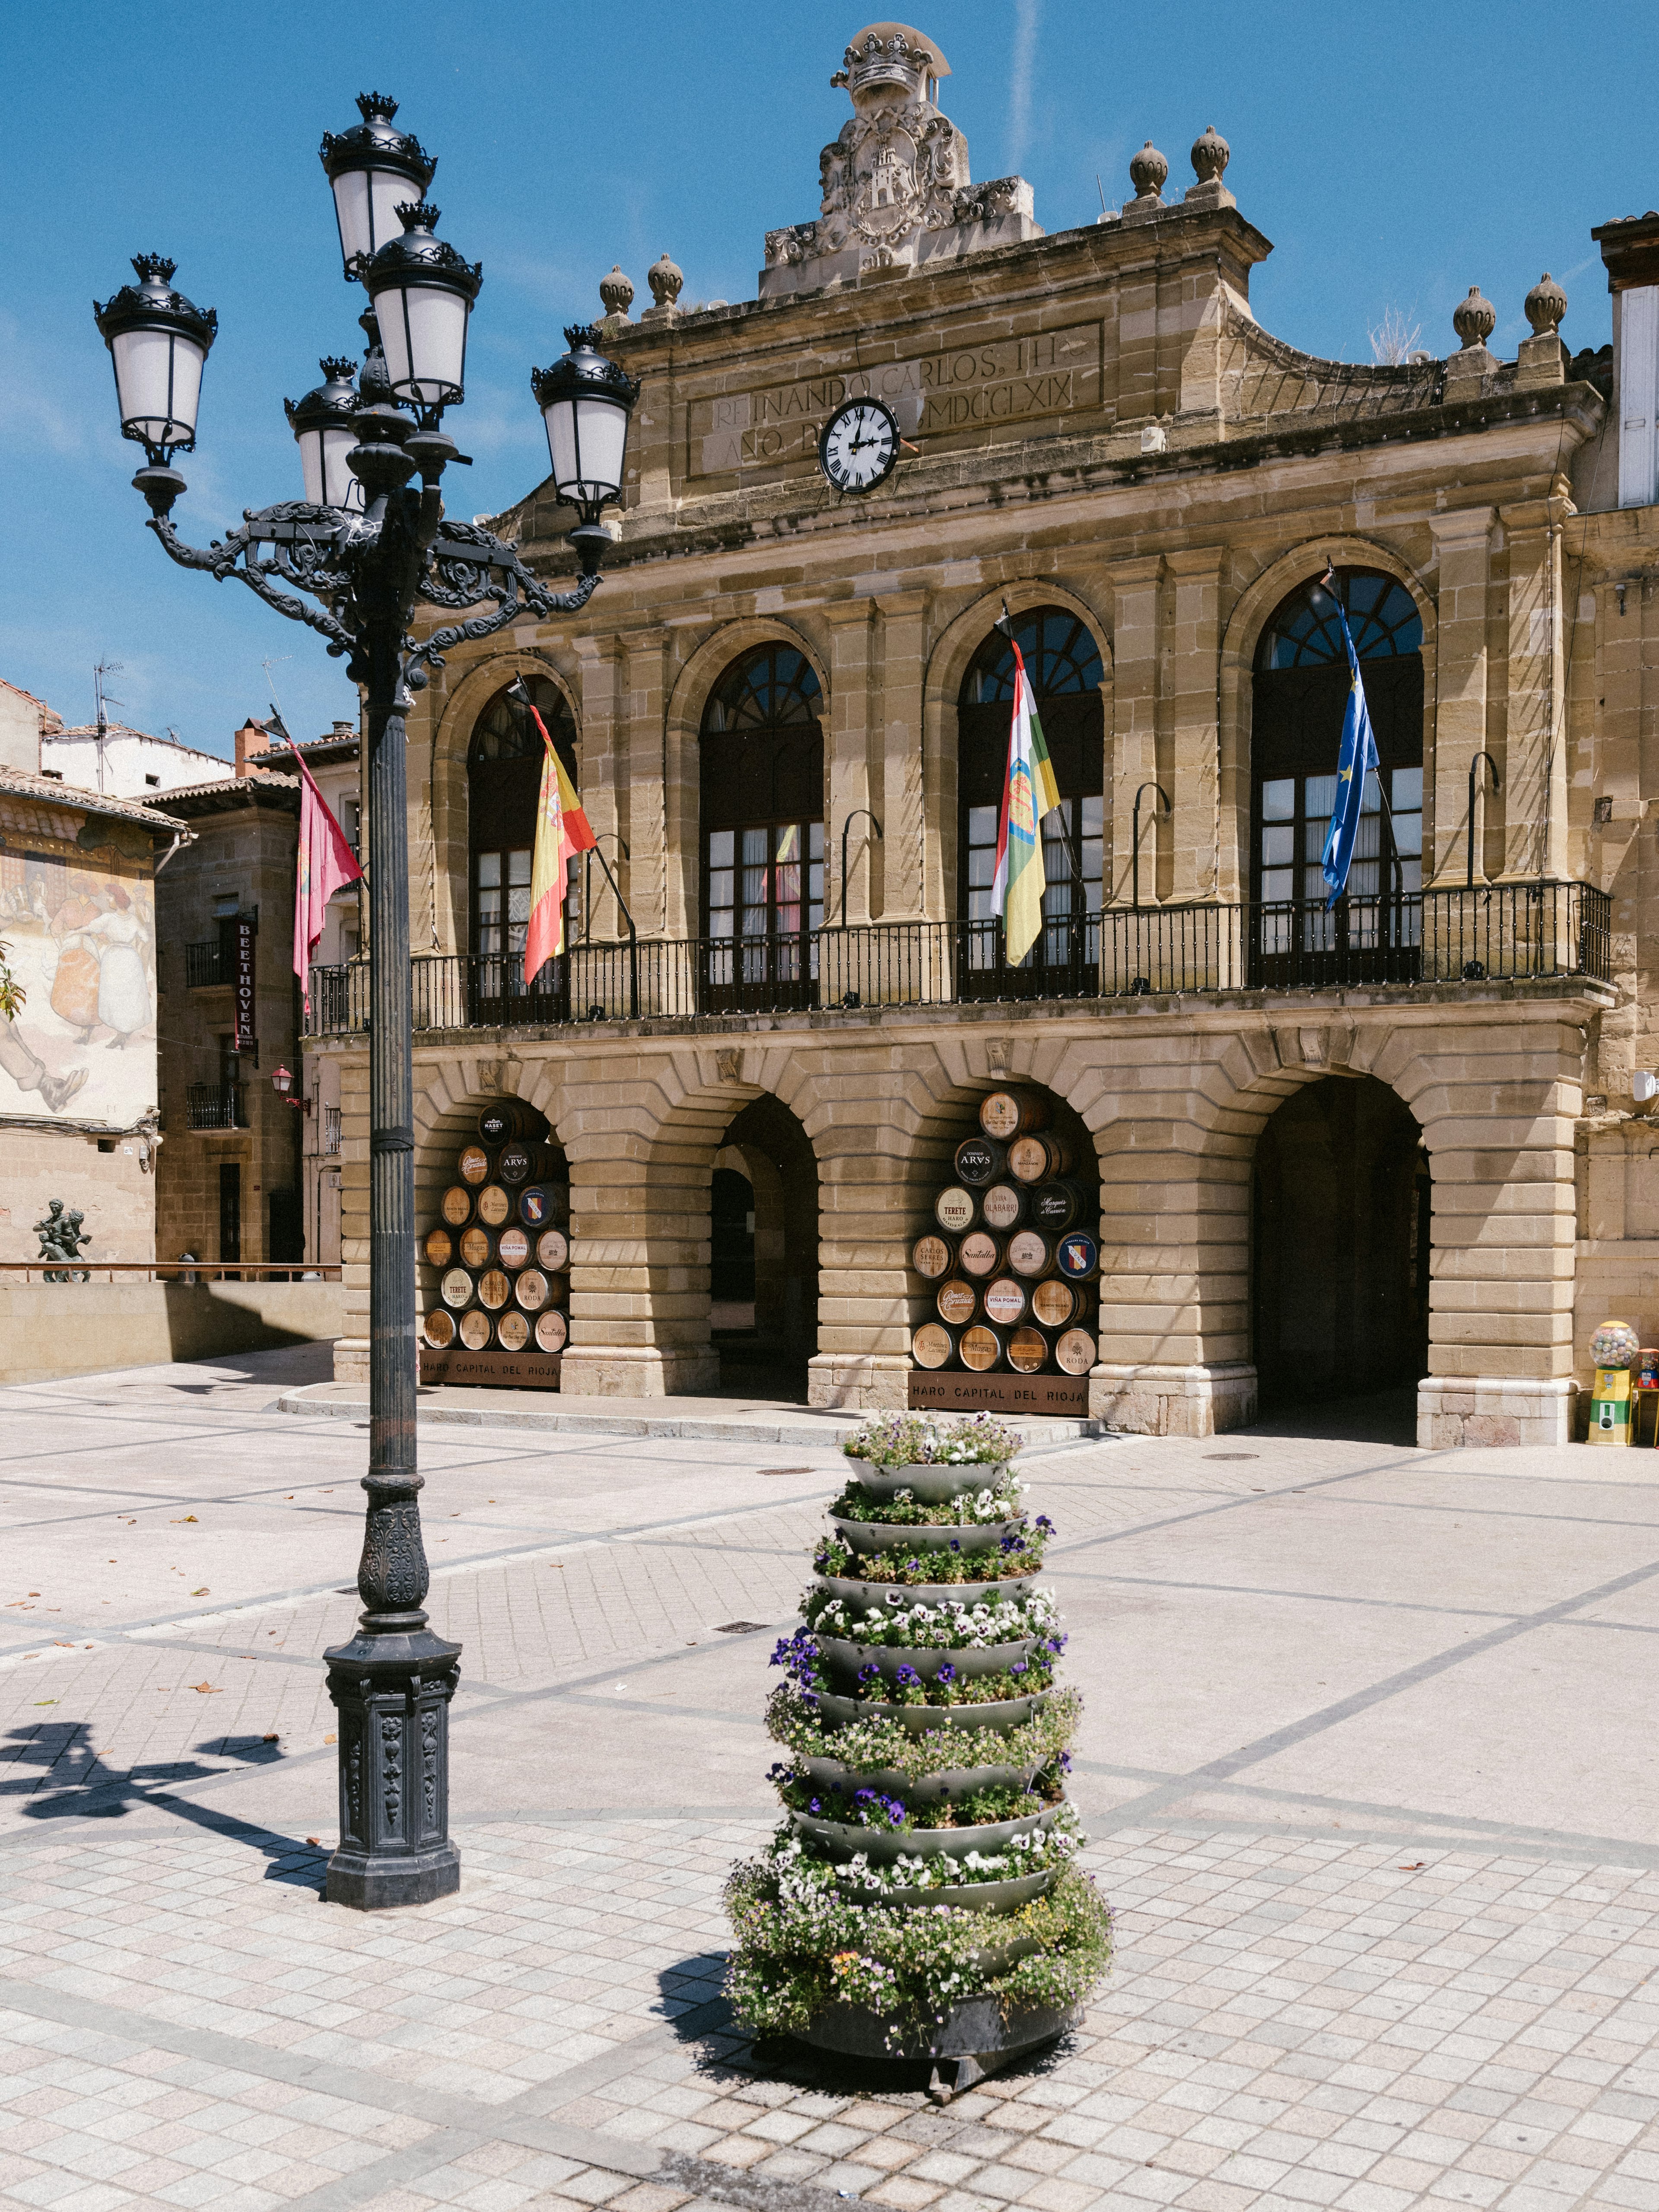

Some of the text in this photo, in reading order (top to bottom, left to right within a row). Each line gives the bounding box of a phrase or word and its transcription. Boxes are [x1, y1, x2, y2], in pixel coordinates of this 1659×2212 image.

[1016, 337, 1056, 371] III
[239, 925, 251, 1034] BEETHOVEN
[1041, 1197, 1067, 1208] Marqués
[985, 1204, 1017, 1213] OLABARRI
[1045, 1206, 1066, 1214] Carrión
[942, 1217, 969, 1227] BODEGAS
[963, 1248, 995, 1259] Santalba
[448, 1296, 468, 1305] BODEGAS
[943, 1290, 964, 1302] Gómez
[941, 1294, 974, 1310] Cruzado
[539, 1327, 566, 1336] Santalba
[968, 1344, 992, 1353] Muga
[423, 1362, 557, 1376] HARO CAPITAL DEL RIOJA
[913, 1386, 1084, 1402] HARO CAPITAL DEL RIOJA
